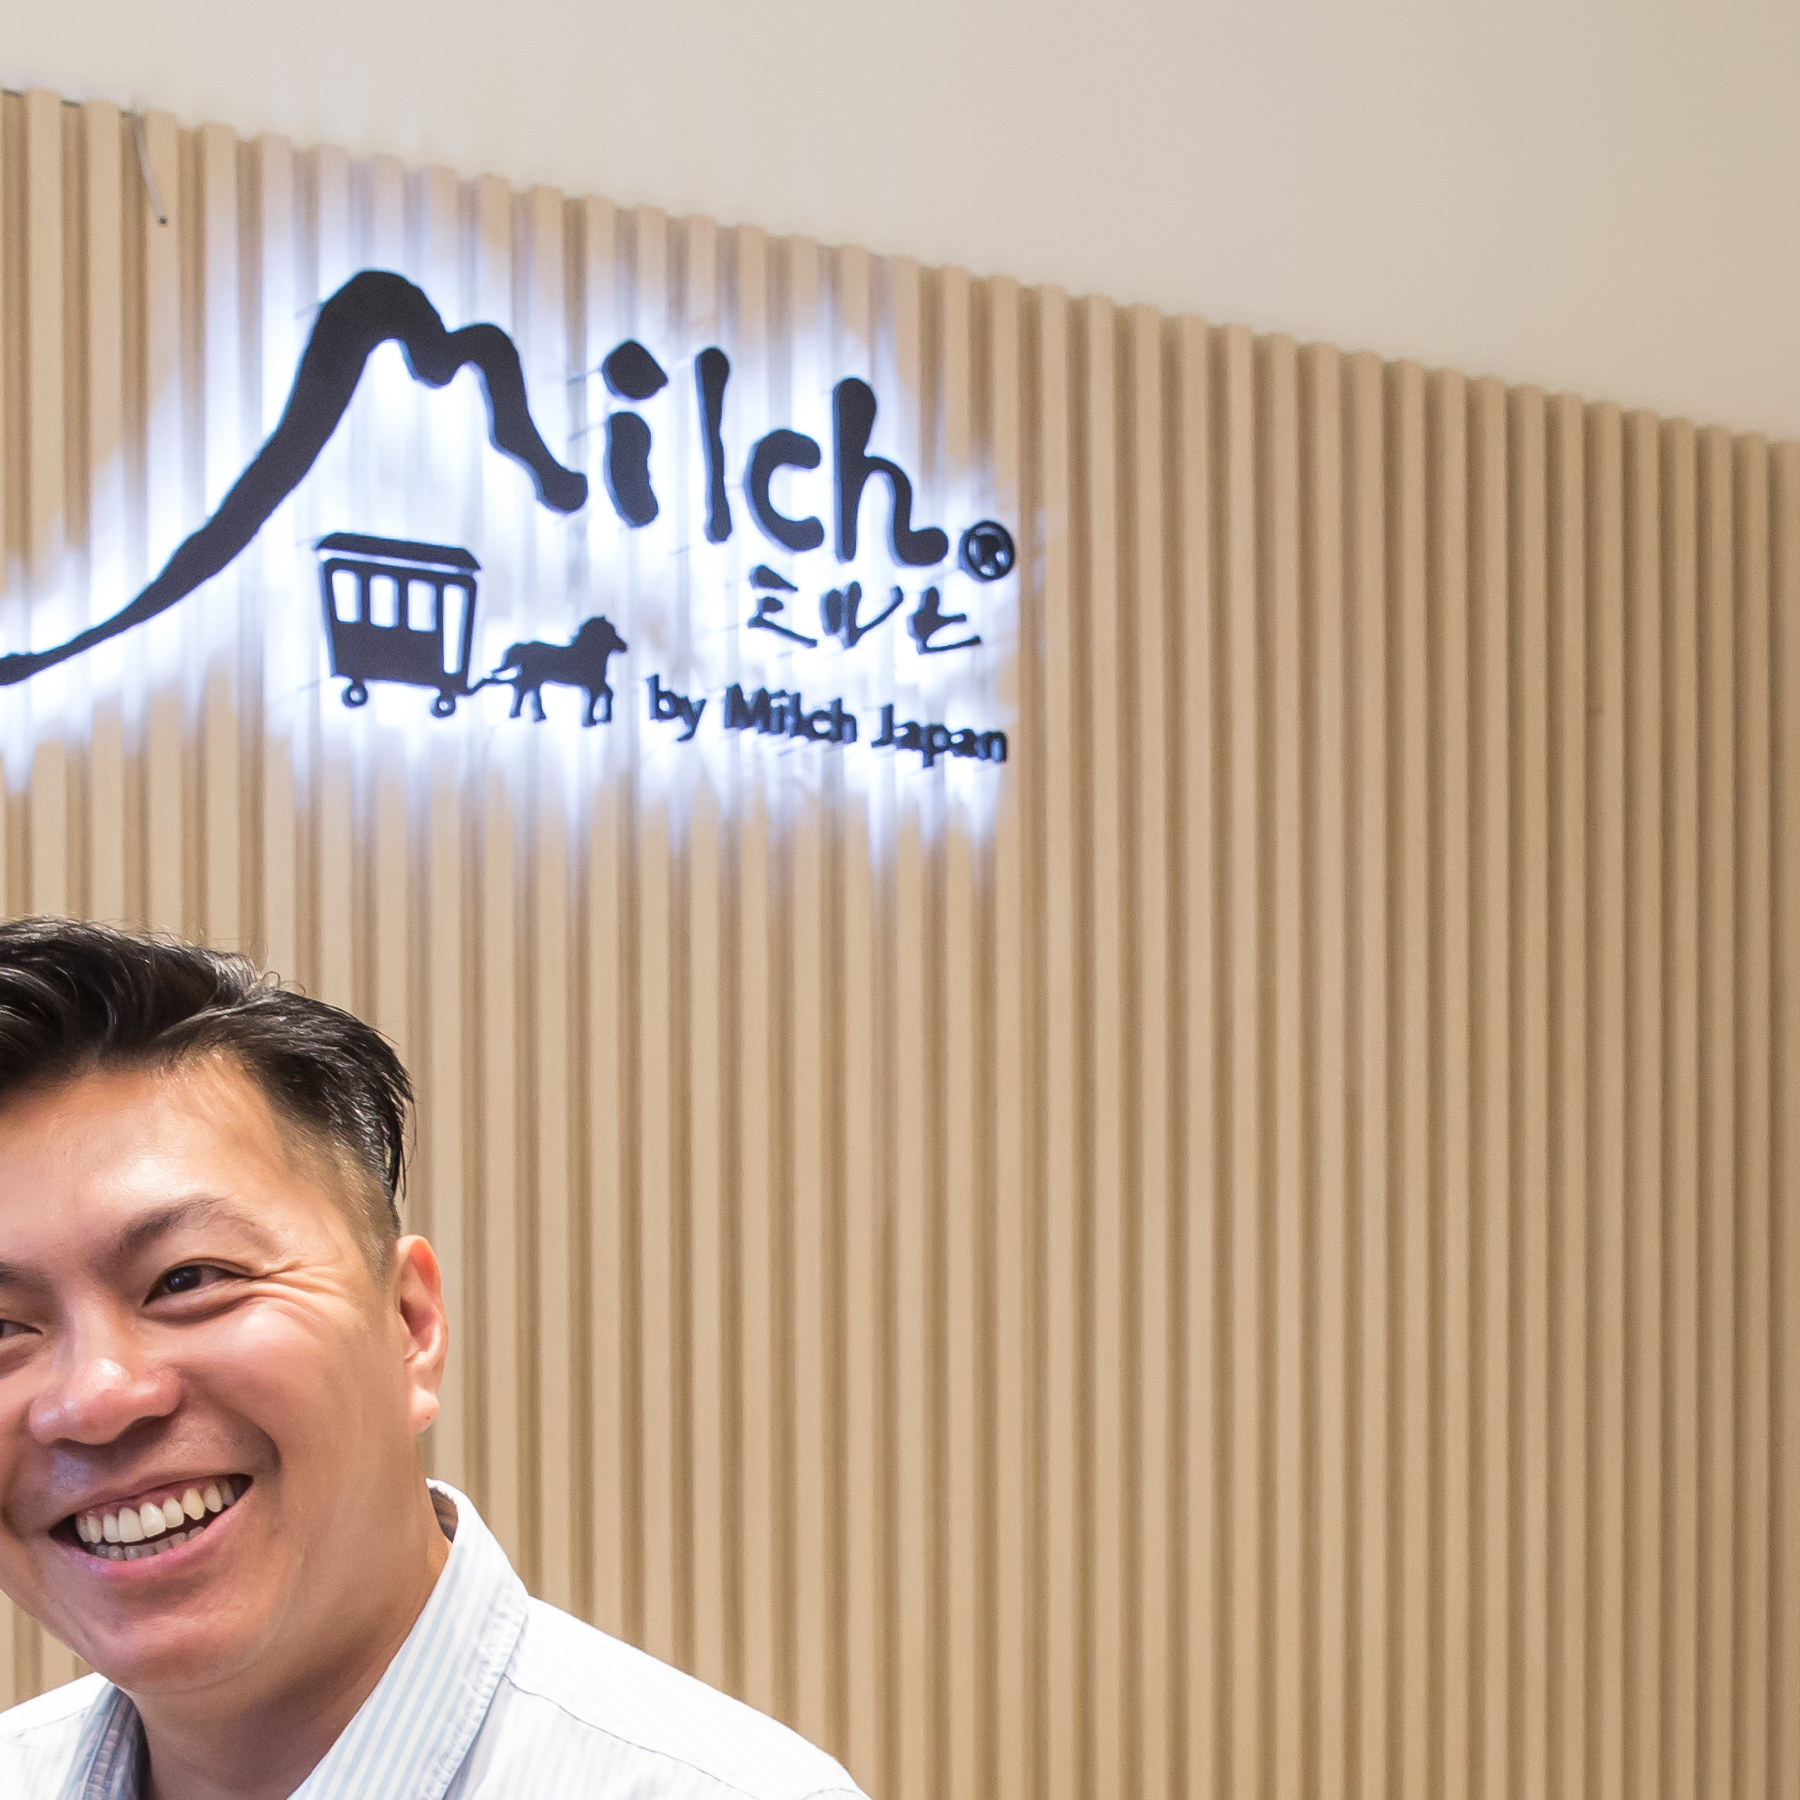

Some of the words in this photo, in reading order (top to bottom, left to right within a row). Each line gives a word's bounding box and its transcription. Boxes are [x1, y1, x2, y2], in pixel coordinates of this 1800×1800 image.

[646, 673, 707, 742] by
[723, 682, 858, 744] Milch
[870, 702, 1008, 768] Japan
